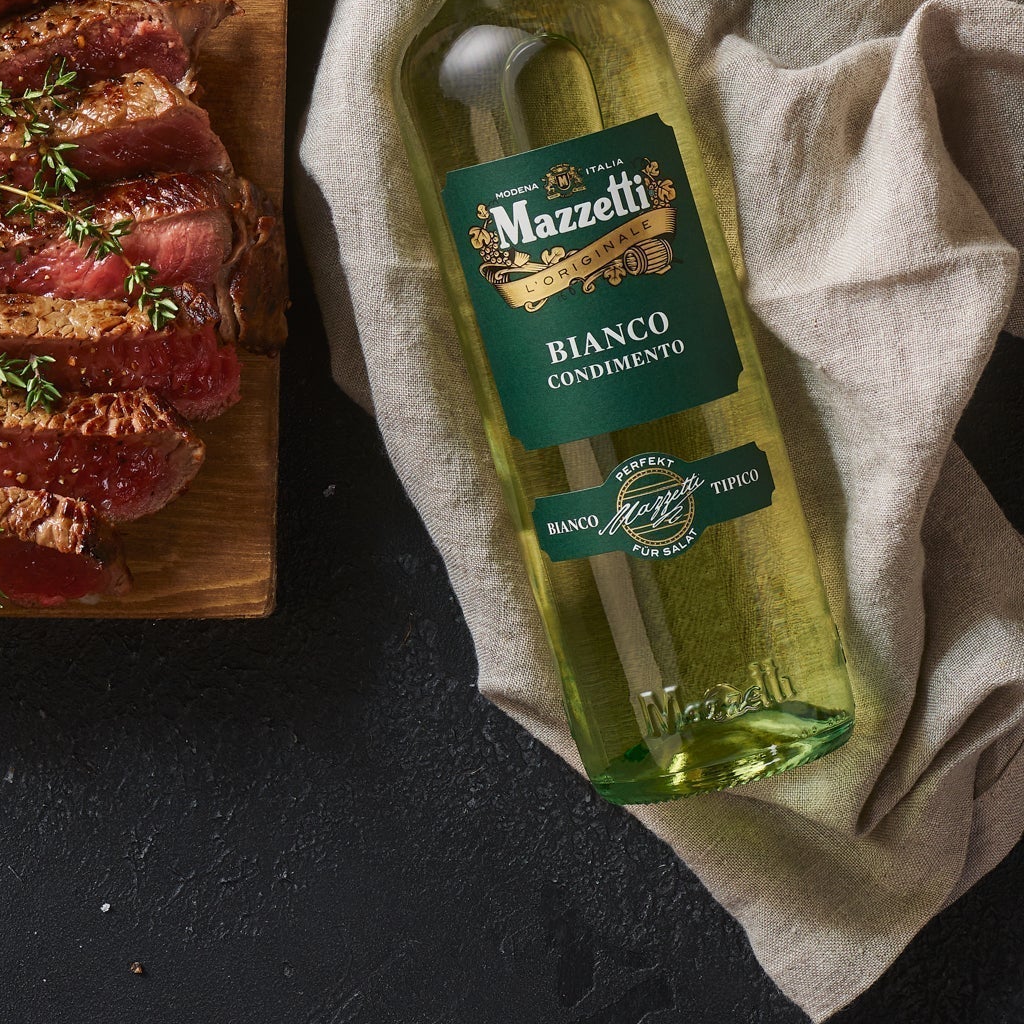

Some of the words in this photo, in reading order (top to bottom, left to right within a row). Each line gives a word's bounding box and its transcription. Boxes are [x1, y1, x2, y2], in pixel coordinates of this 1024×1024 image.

[585, 158, 624, 175] ITALIA
[495, 182, 539, 200] MODENA
[489, 171, 652, 250] Mazzetti
[525, 219, 652, 293] L'ORIGINALE
[545, 311, 670, 365] BIANCO
[547, 339, 685, 389] CONDIMENTO
[615, 456, 675, 482] PERFEKT
[710, 468, 760, 495] TIPICO
[598, 473, 705, 536] Mazzetti
[547, 514, 599, 536] BIANCO
[632, 543, 660, 558] FÜR
[663, 528, 698, 556] SALAT
